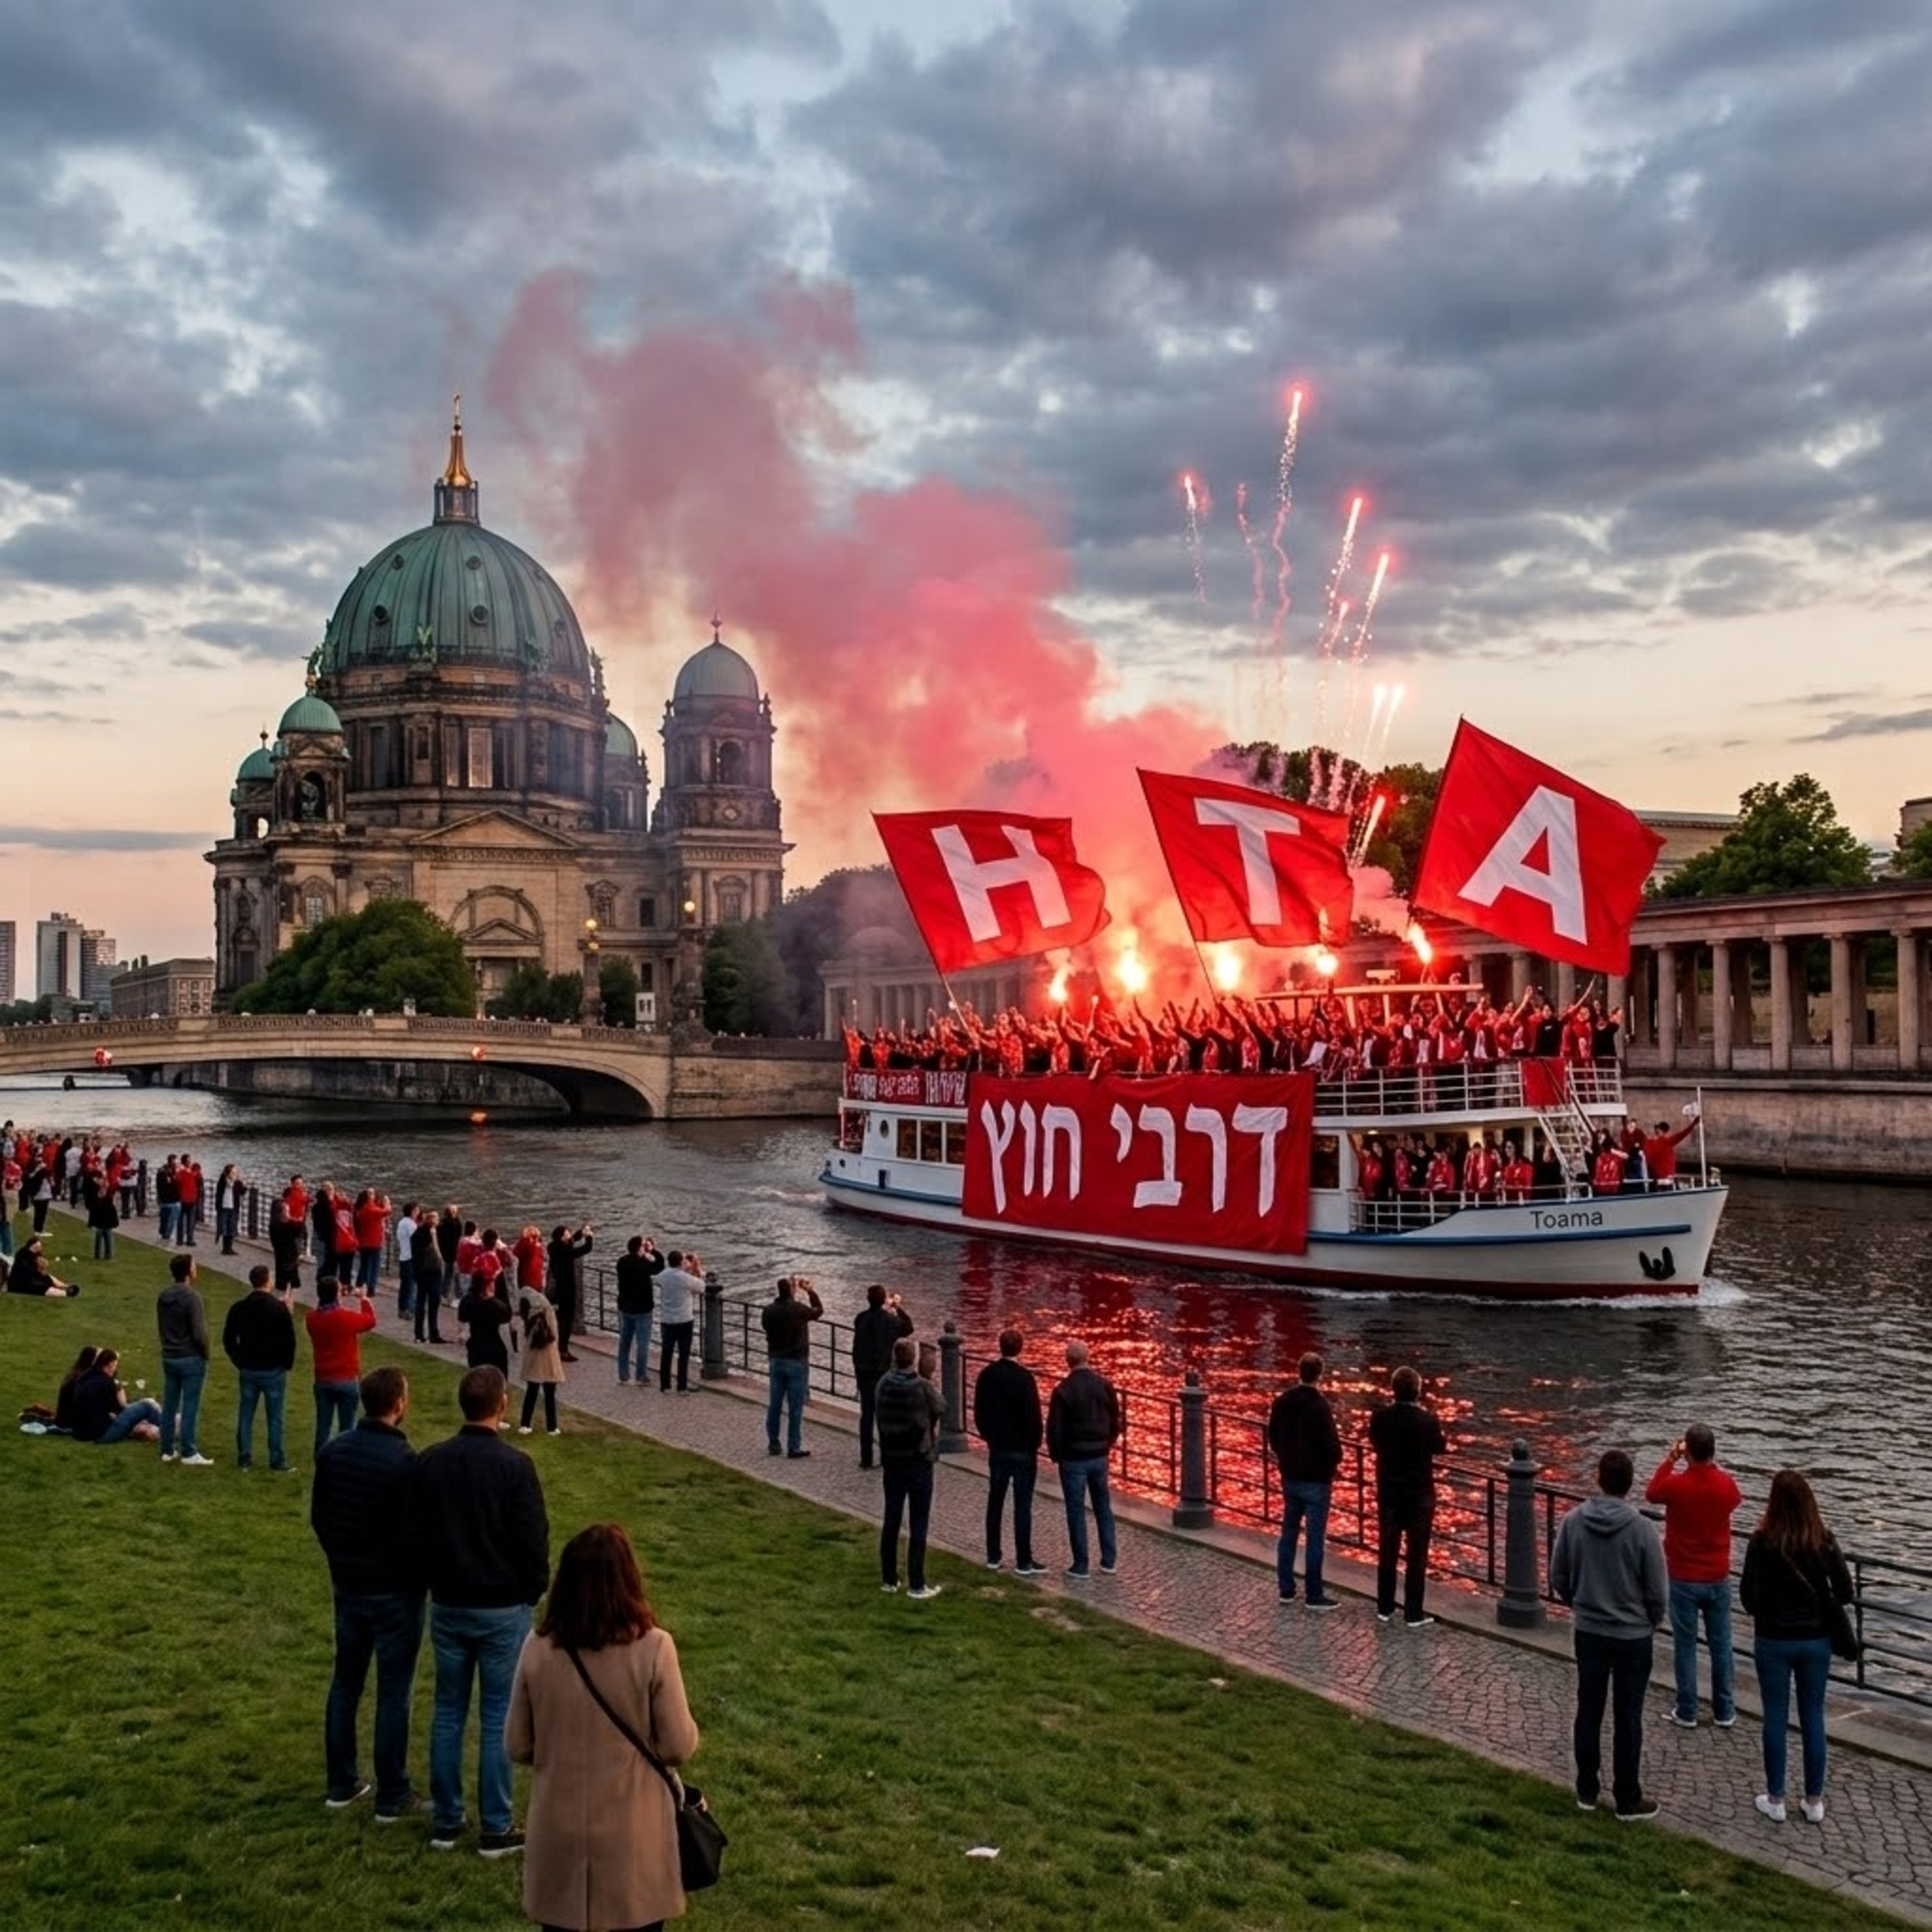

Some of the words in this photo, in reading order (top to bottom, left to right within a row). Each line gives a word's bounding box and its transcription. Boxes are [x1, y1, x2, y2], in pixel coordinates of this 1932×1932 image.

[931, 825, 1071, 943] H
[1195, 798, 1300, 925] T
[1458, 785, 1587, 945] A
[980, 1099, 1082, 1215] חוץ
[1110, 1102, 1288, 1218] דרבי
[1530, 1209, 1604, 1229] Toama
